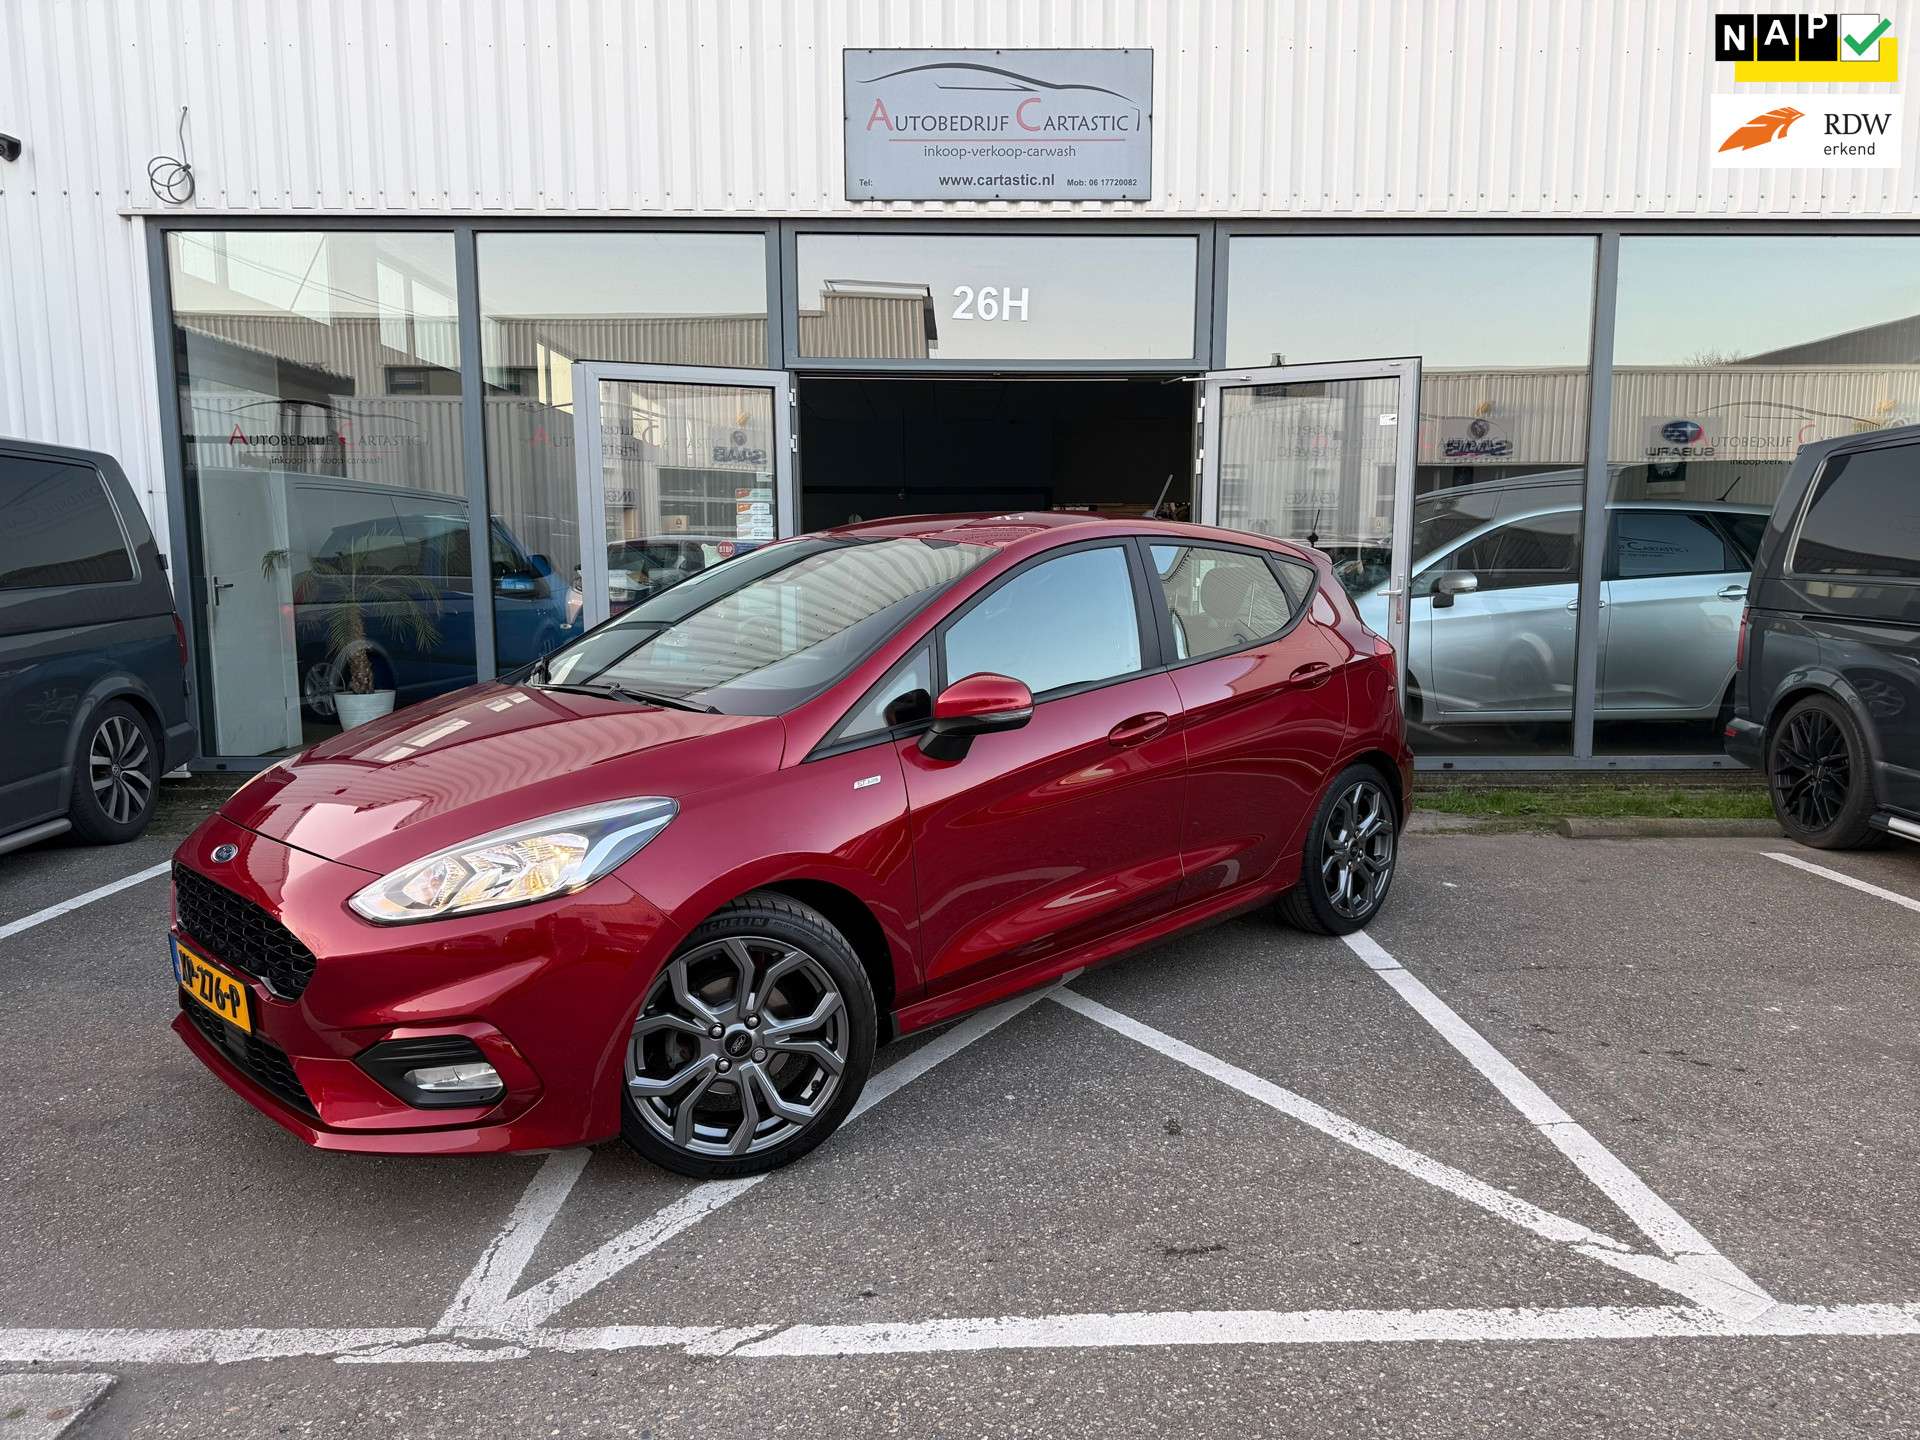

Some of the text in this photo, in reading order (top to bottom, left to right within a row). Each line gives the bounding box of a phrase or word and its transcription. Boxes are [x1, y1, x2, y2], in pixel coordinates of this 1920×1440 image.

[866, 97, 1129, 132] AUTOBEDRIJF CARTASTIC
[924, 145, 1076, 159] inkoop-verkoop-carwash
[859, 178, 873, 188] Tel:
[939, 174, 1055, 187] www.cartastic.nl
[1067, 178, 1138, 187] Mob: 06 17720082
[951, 285, 1029, 322] 26H
